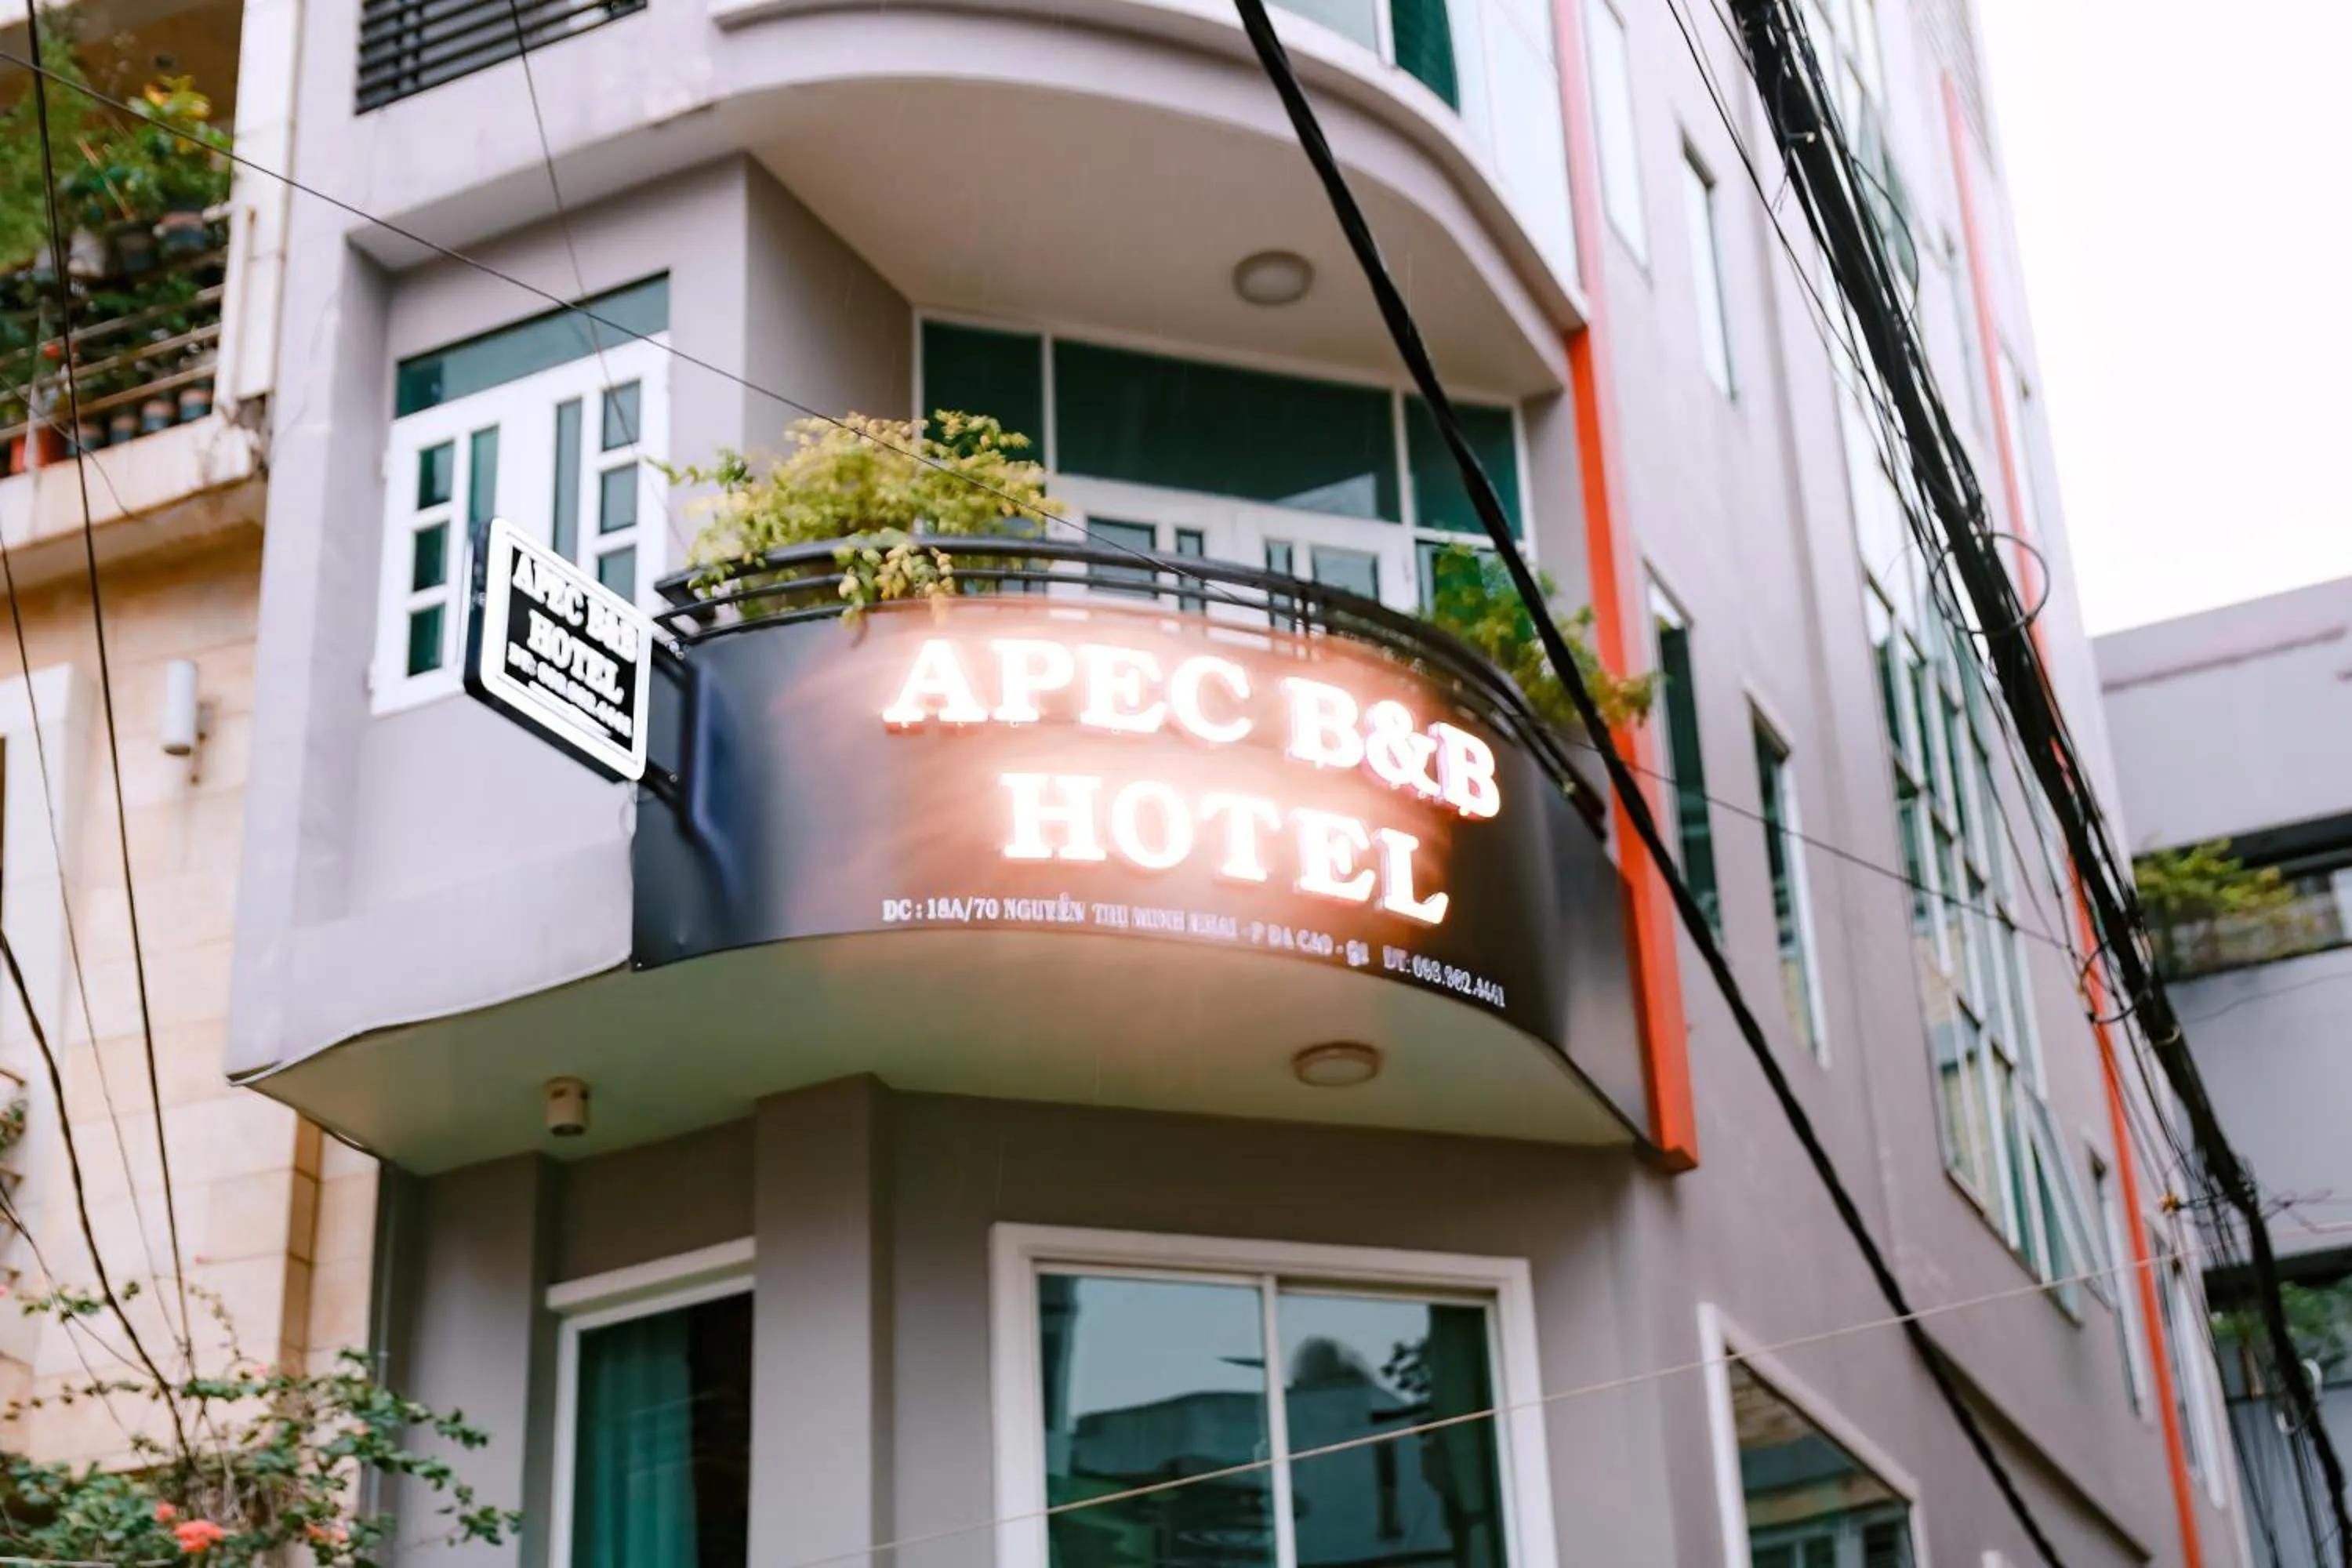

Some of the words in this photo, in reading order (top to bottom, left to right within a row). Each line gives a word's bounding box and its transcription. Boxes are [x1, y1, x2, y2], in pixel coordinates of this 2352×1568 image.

[513, 552, 584, 626] APEC
[527, 608, 624, 704] HOTEL
[882, 638, 1254, 744] APEC
[1285, 677, 1501, 819] B&B
[1000, 771, 1449, 925] HOTEL
